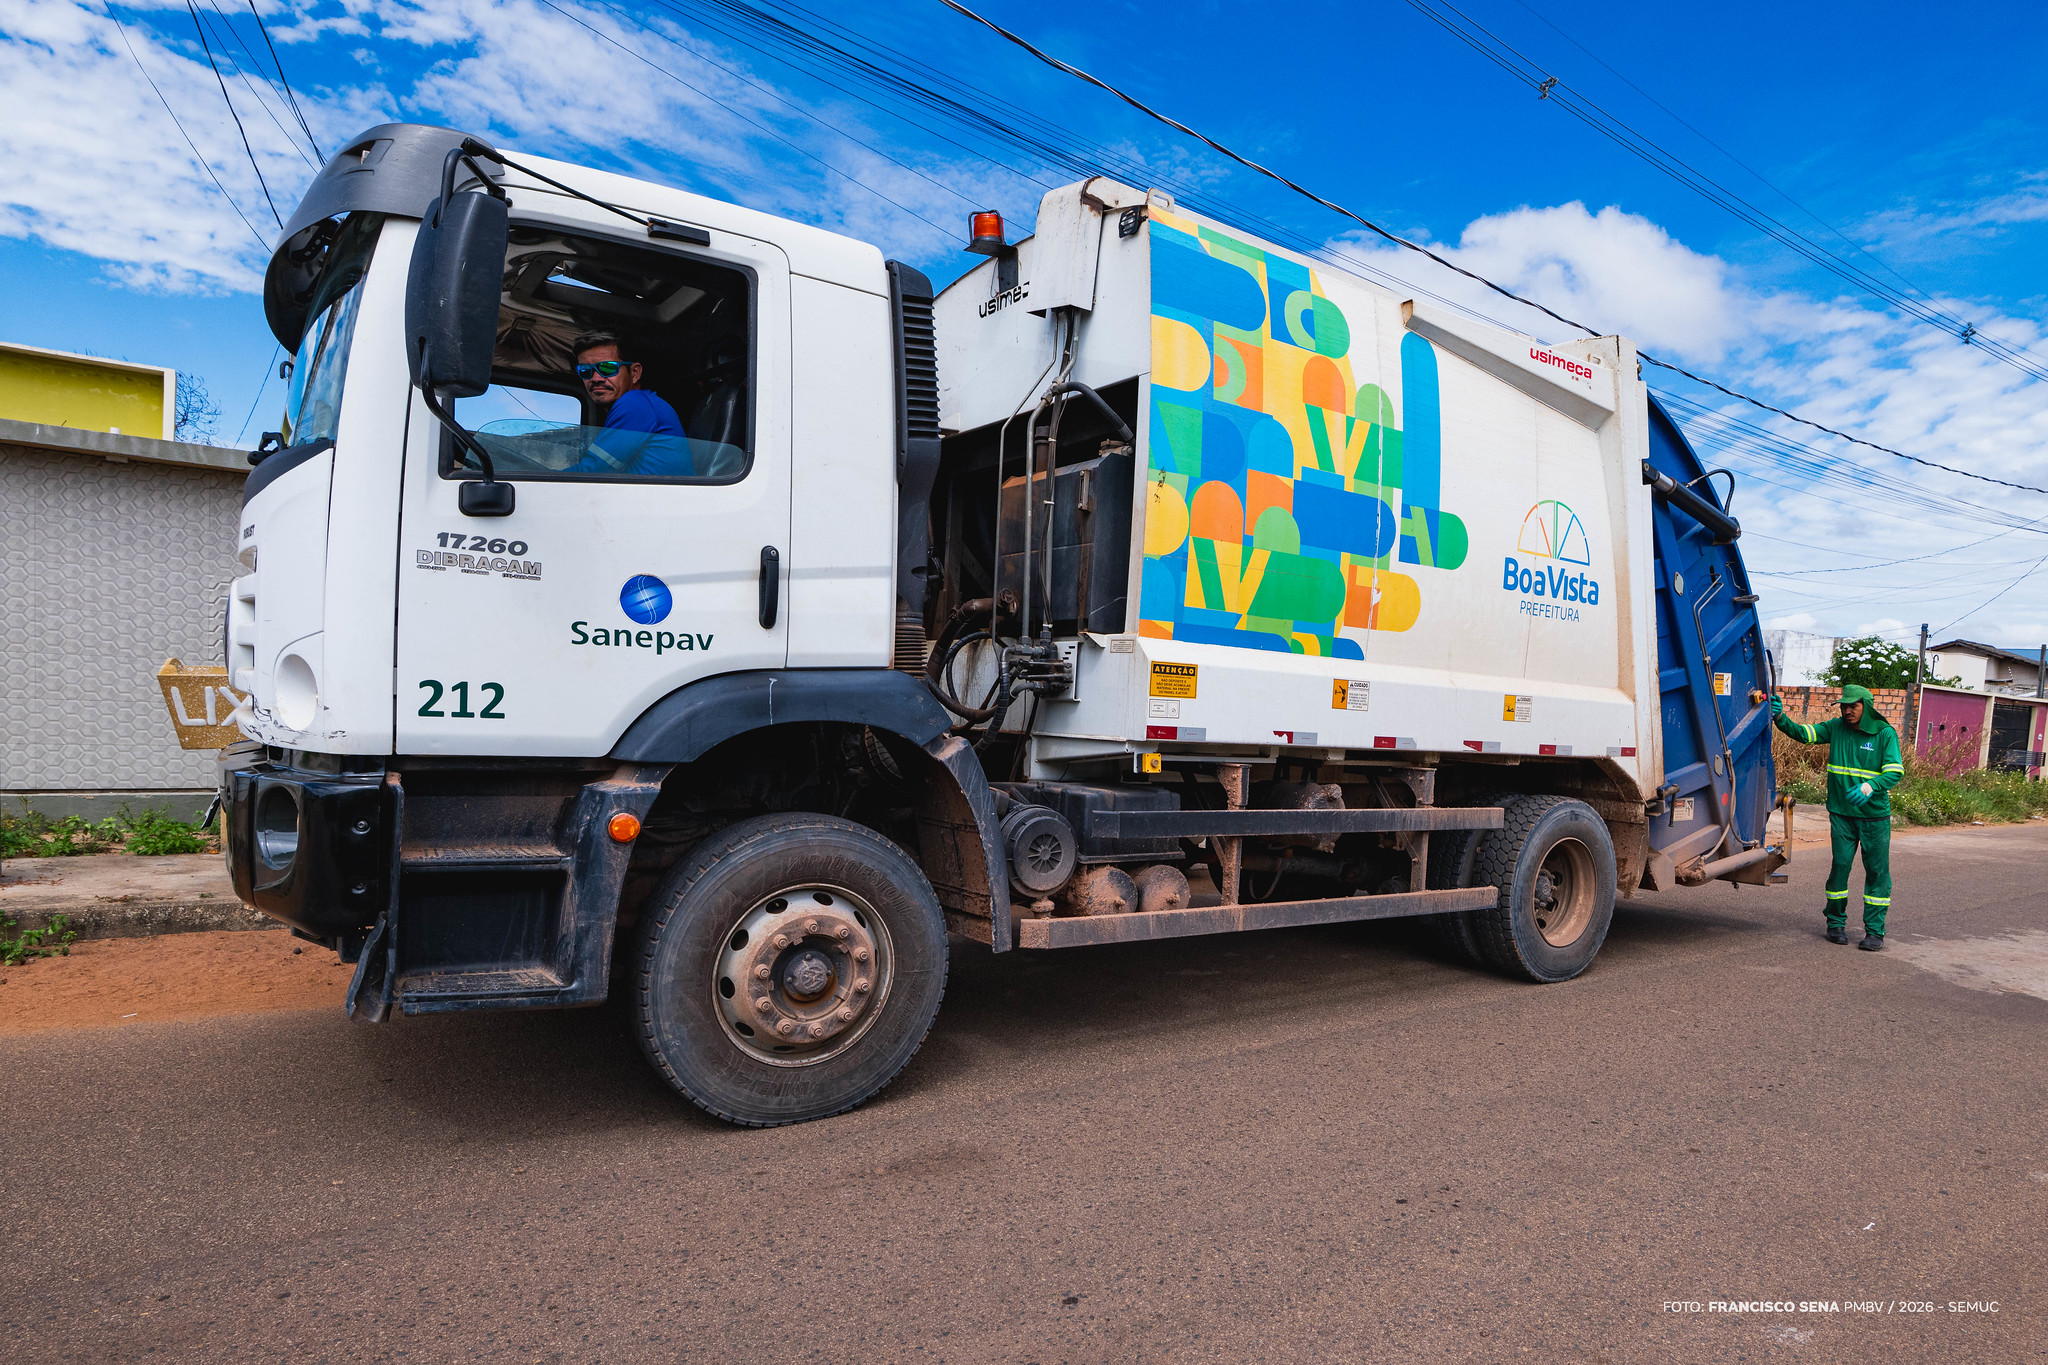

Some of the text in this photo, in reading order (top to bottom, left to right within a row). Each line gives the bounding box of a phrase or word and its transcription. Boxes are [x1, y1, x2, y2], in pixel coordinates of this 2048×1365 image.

[1529, 347, 1592, 380] usimeca
[436, 531, 529, 556] 17.260
[416, 549, 542, 576] DIBRACAM
[1519, 600, 1580, 622] PREFEITURA
[571, 620, 714, 655] Sanepav
[1155, 665, 1194, 675] ATENÇÃO
[418, 679, 505, 719] 212
